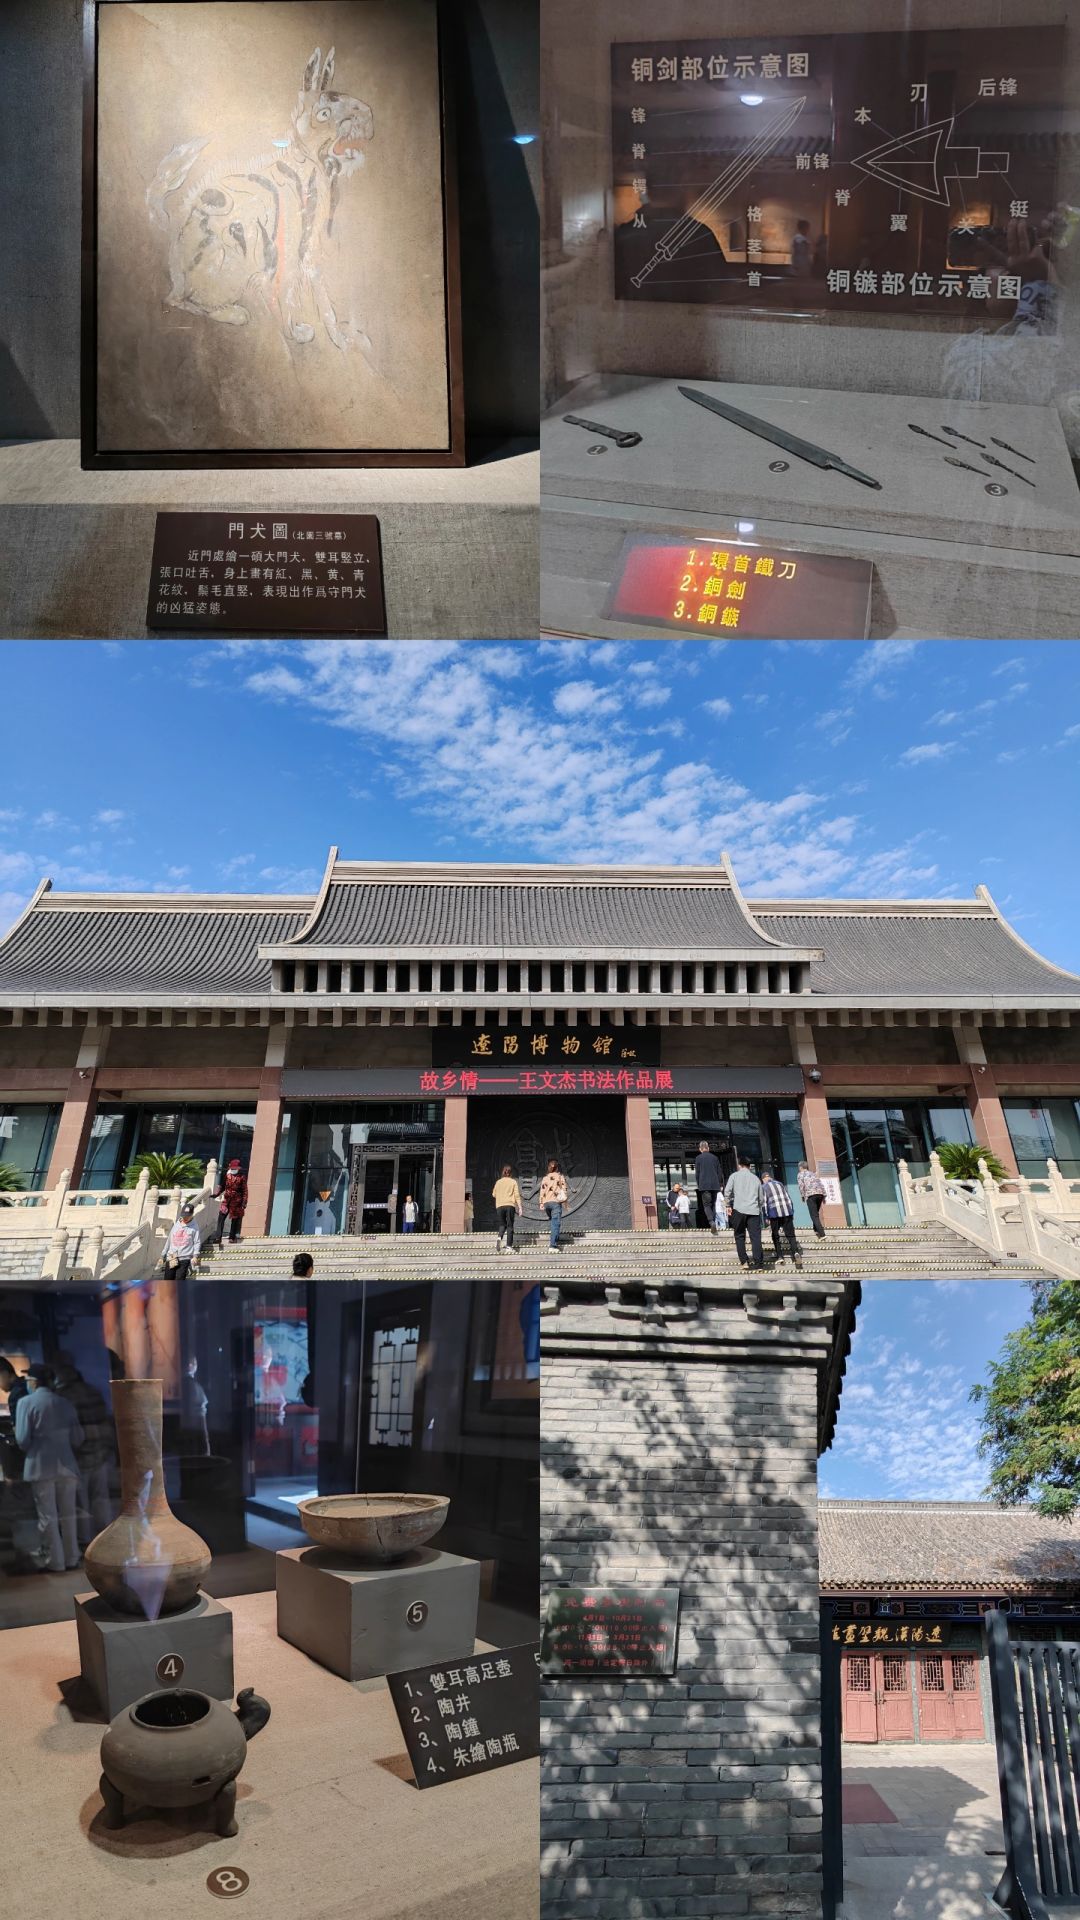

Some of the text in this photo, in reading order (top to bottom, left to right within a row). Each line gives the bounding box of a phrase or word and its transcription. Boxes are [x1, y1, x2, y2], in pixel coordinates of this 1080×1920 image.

[631, 53, 810, 82] 铜剑部位示意图
[910, 84, 928, 102] 刃
[978, 77, 1018, 97] 后锋
[630, 108, 647, 125] 锋
[854, 107, 872, 125] 本
[631, 143, 647, 160] 脊
[795, 152, 830, 171] 前锋
[834, 188, 851, 206] 脊
[747, 205, 763, 223] 格
[1010, 200, 1028, 218] 铤
[632, 213, 648, 230] 从
[890, 213, 908, 232] 翼
[747, 238, 763, 256] 茎
[747, 271, 763, 288] 首
[826, 268, 1022, 301] 铜镞部位示意图
[228, 522, 288, 540] 門犬圖
[419, 1070, 674, 1091] 故乡情——王文杰书法作品展
[410, 1693, 471, 1724] 2、陶井
[426, 1733, 520, 1774] 4、朱繪陶瓶
